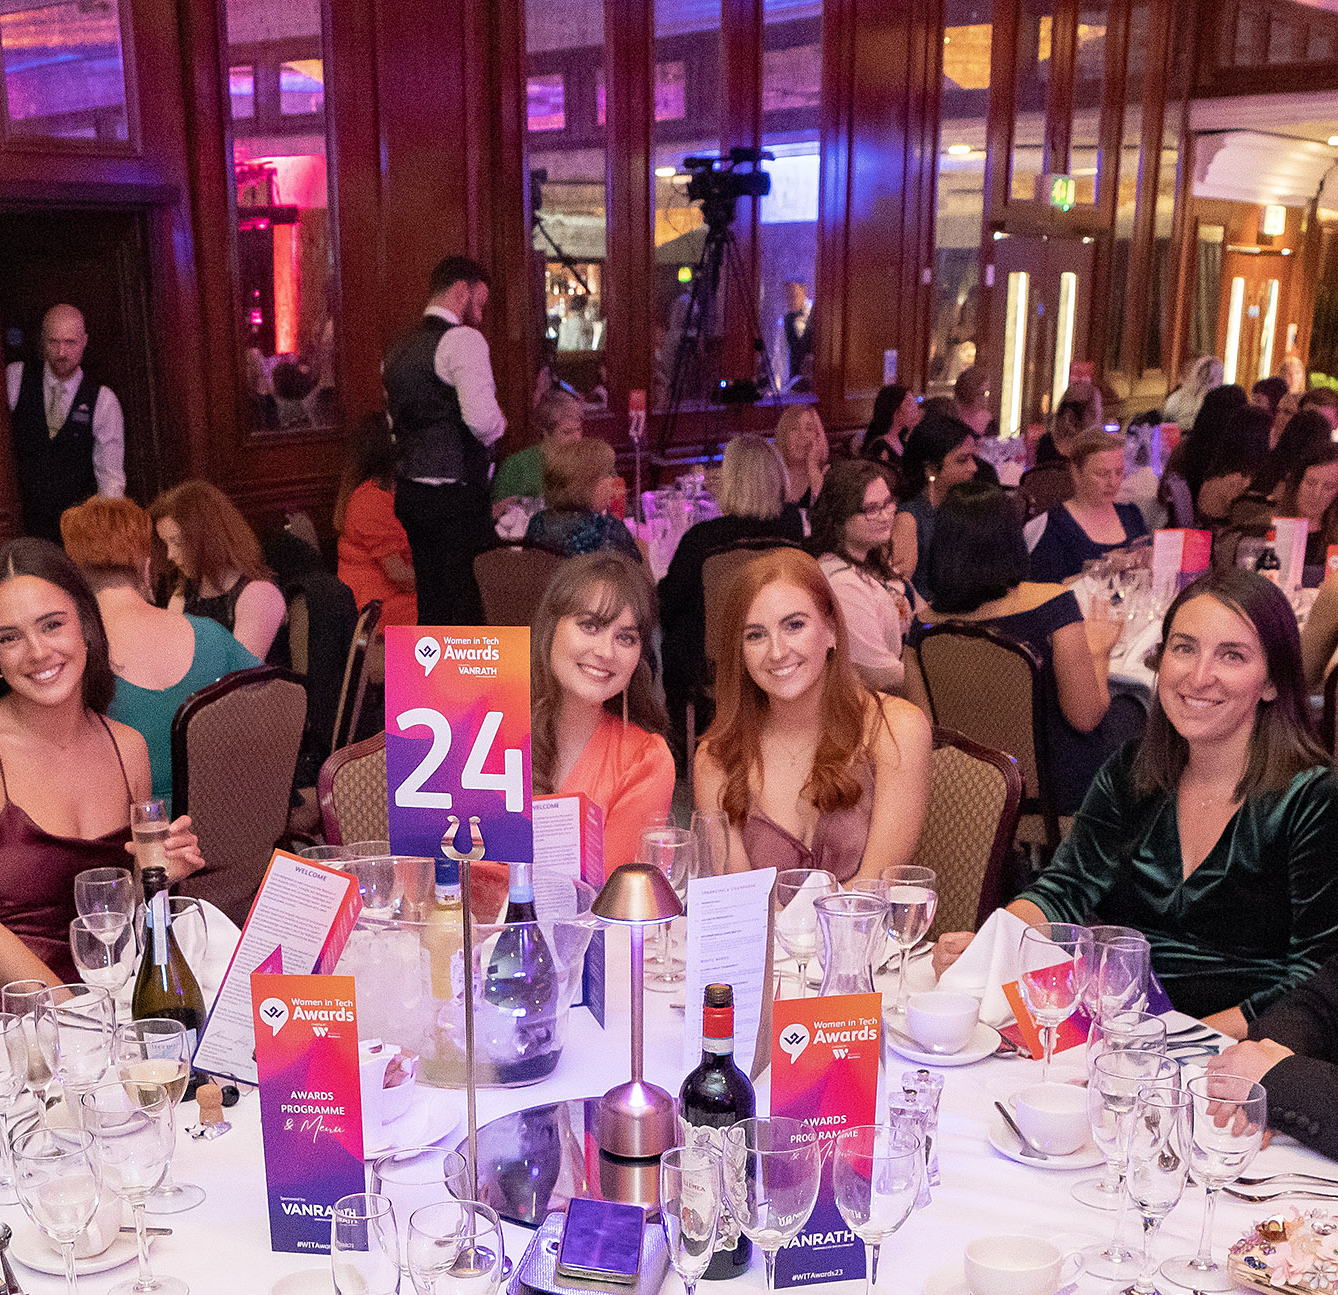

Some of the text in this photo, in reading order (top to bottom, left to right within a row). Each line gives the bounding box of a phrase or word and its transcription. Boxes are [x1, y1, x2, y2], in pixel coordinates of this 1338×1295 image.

[443, 637, 499, 645] Women in Tech
[443, 645, 499, 660] Awards
[458, 666, 497, 675] VANRATH
[395, 708, 523, 812] 24
[295, 866, 327, 881] WELCOME
[291, 998, 354, 1007] Women in Tech
[292, 1006, 355, 1022] Awards
[814, 1020, 846, 1029] Women
[858, 1017, 878, 1026] Tech
[813, 1026, 878, 1045] Awards
[291, 1091, 334, 1101] AWARDS
[281, 1104, 346, 1115] PROGRAMME
[800, 1115, 847, 1127] AWARDS
[284, 1115, 346, 1144] & Menu
[792, 1269, 844, 1281] #WITAwards23
